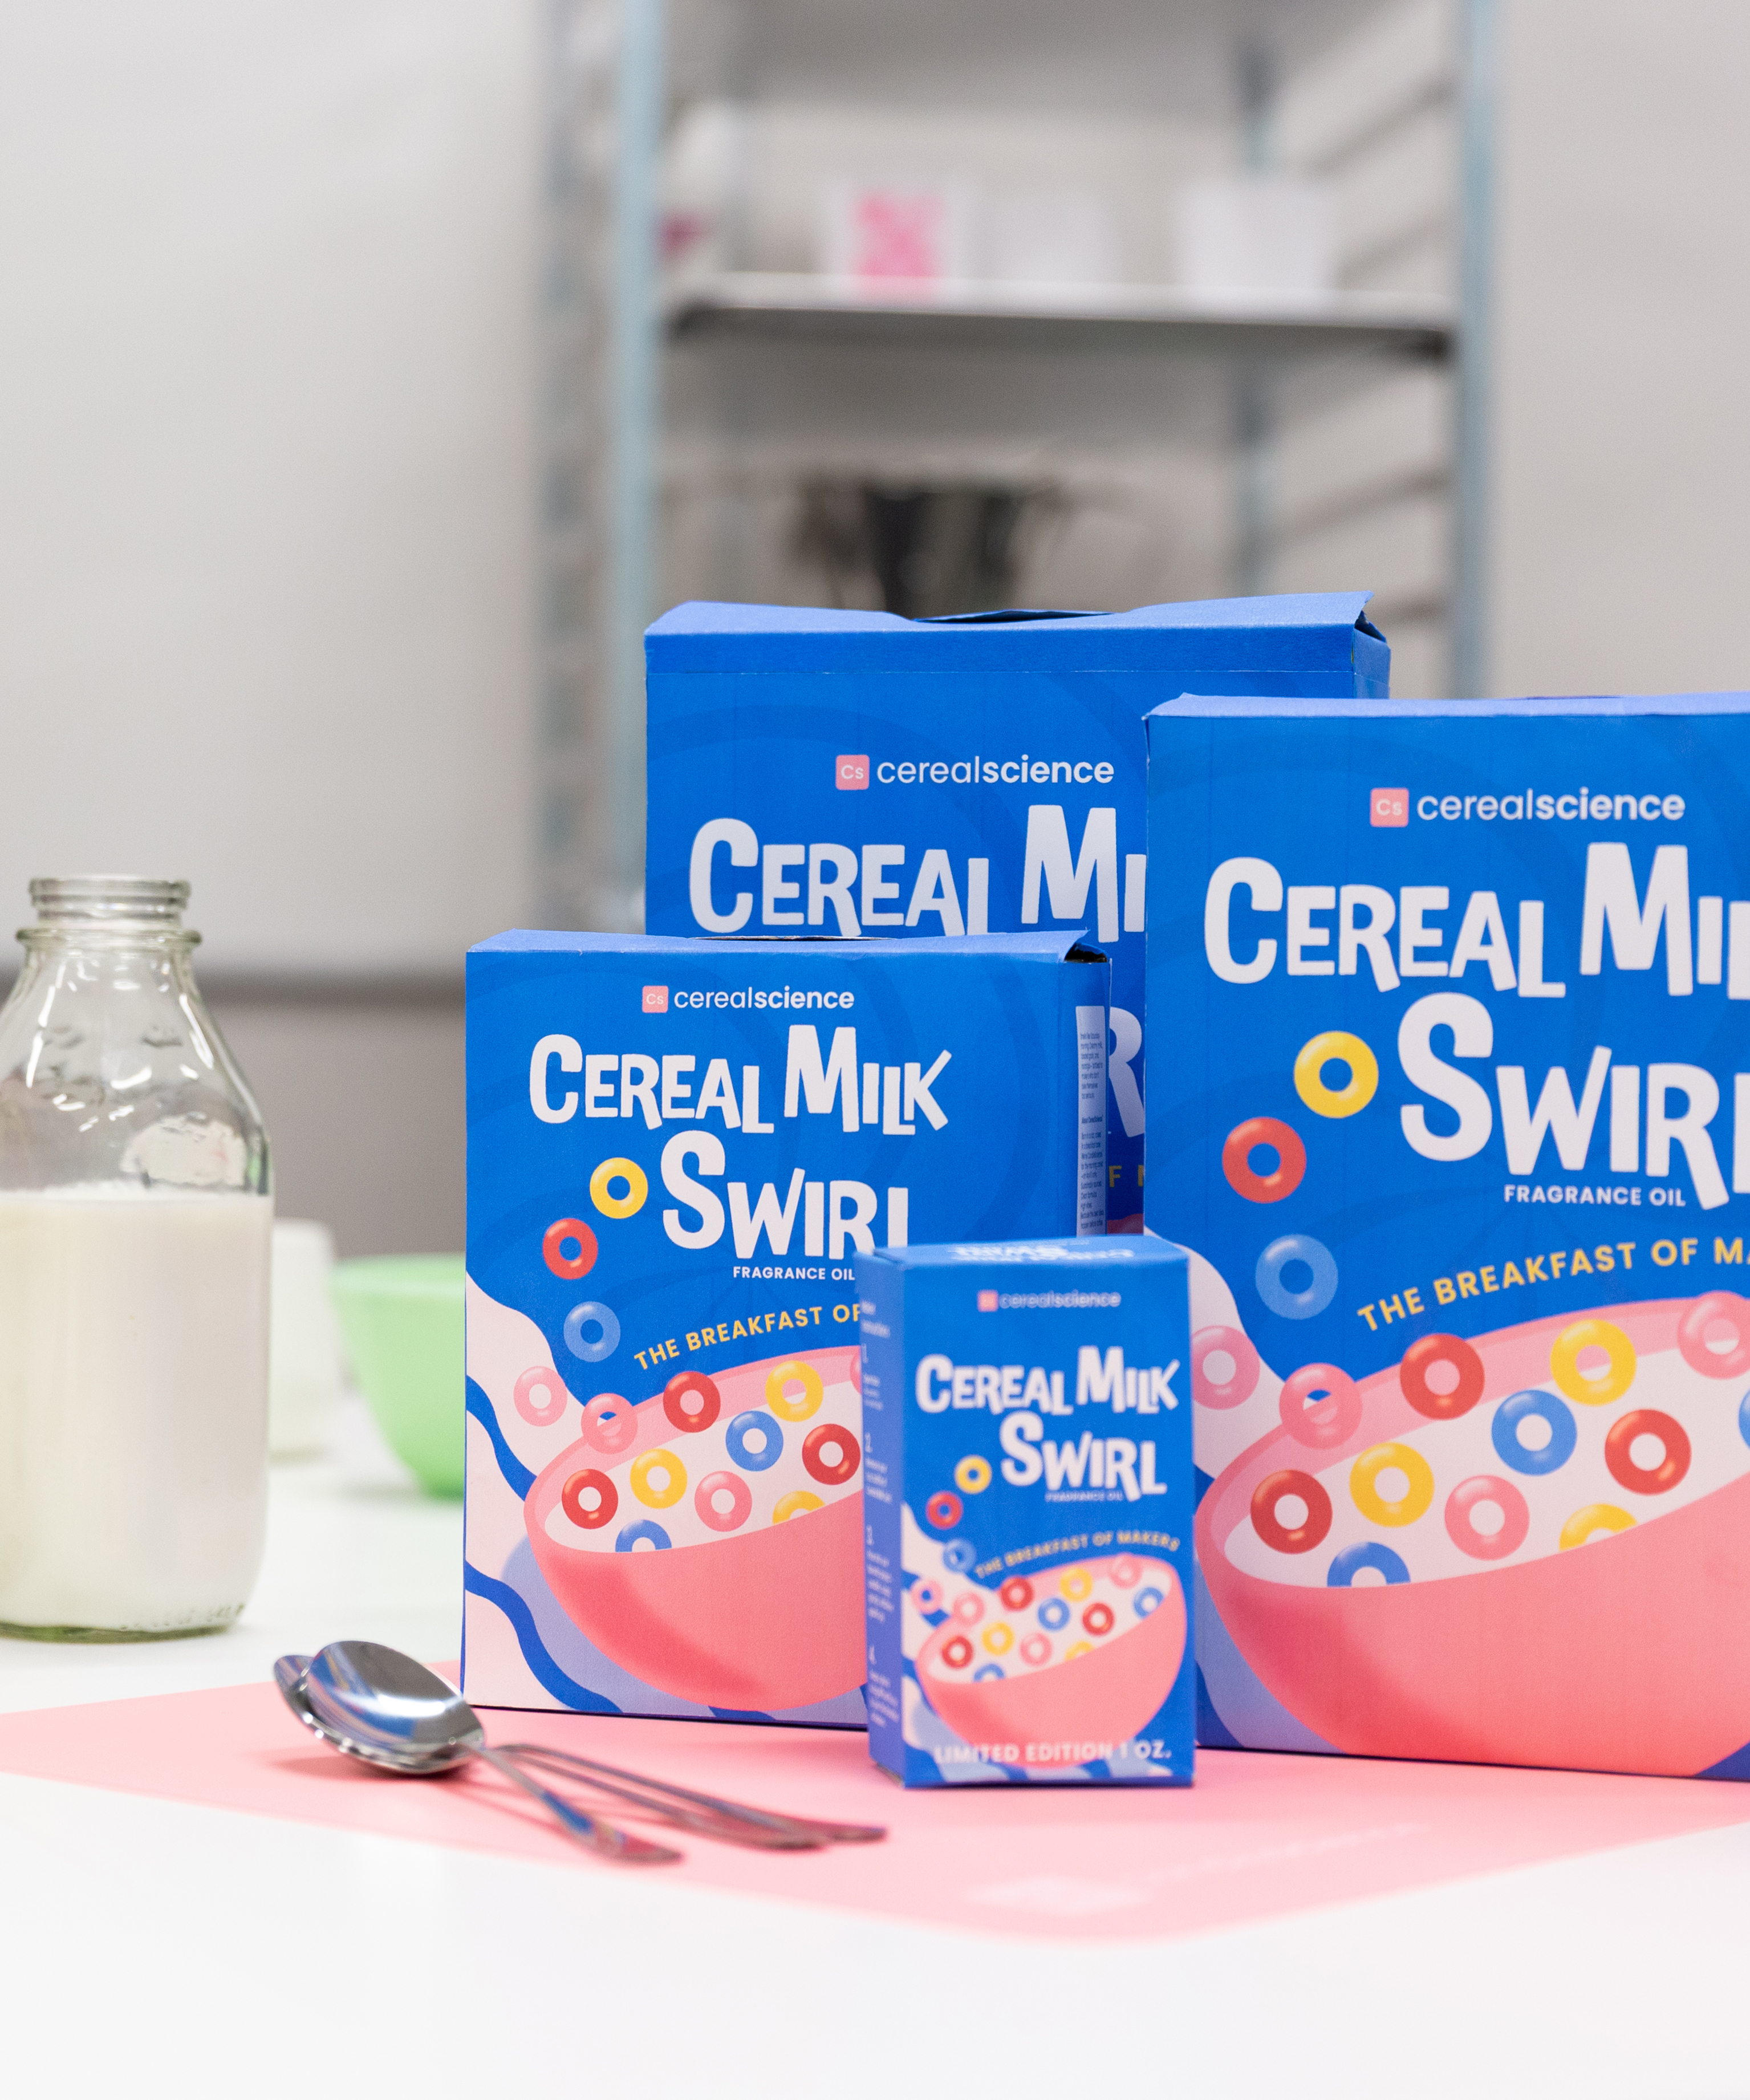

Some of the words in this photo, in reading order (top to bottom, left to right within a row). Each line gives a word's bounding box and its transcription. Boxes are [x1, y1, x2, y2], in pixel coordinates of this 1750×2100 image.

[841, 765, 864, 779] Cs
[877, 754, 1114, 783] cerealscience
[1376, 799, 1402, 816] Cs
[1417, 787, 1686, 820] cerealscience
[1204, 857, 1566, 998] CEREAL
[646, 993, 664, 1005] Cs
[674, 986, 855, 1009] cerealscience
[530, 1034, 774, 1134] CEREAL
[784, 1025, 952, 1135] MILK
[1504, 1185, 1641, 1205] FRAGRANCE
[1649, 1188, 1686, 1207] OIL
[733, 1266, 826, 1280] FRAGRANCE
[831, 1268, 855, 1281] OIL
[1357, 1287, 1425, 1331] THE
[1433, 1242, 1637, 1305] BREAKFAST
[1651, 1238, 1698, 1266] OF
[634, 1338, 680, 1370] THE
[686, 1306, 823, 1352] BREAKFAST
[916, 1354, 1073, 1415] CEREAL
[1076, 1346, 1180, 1414] MILK
[1000, 1410, 1168, 1502] SWIRL
[976, 1557, 1002, 1578] THE
[1005, 1533, 1088, 1566] BREAKFAST
[1092, 1531, 1113, 1546] OF
[1116, 1530, 1180, 1551] MAKERS
[933, 1743, 1020, 1763] LIMITED
[1026, 1742, 1113, 1762] EDITION
